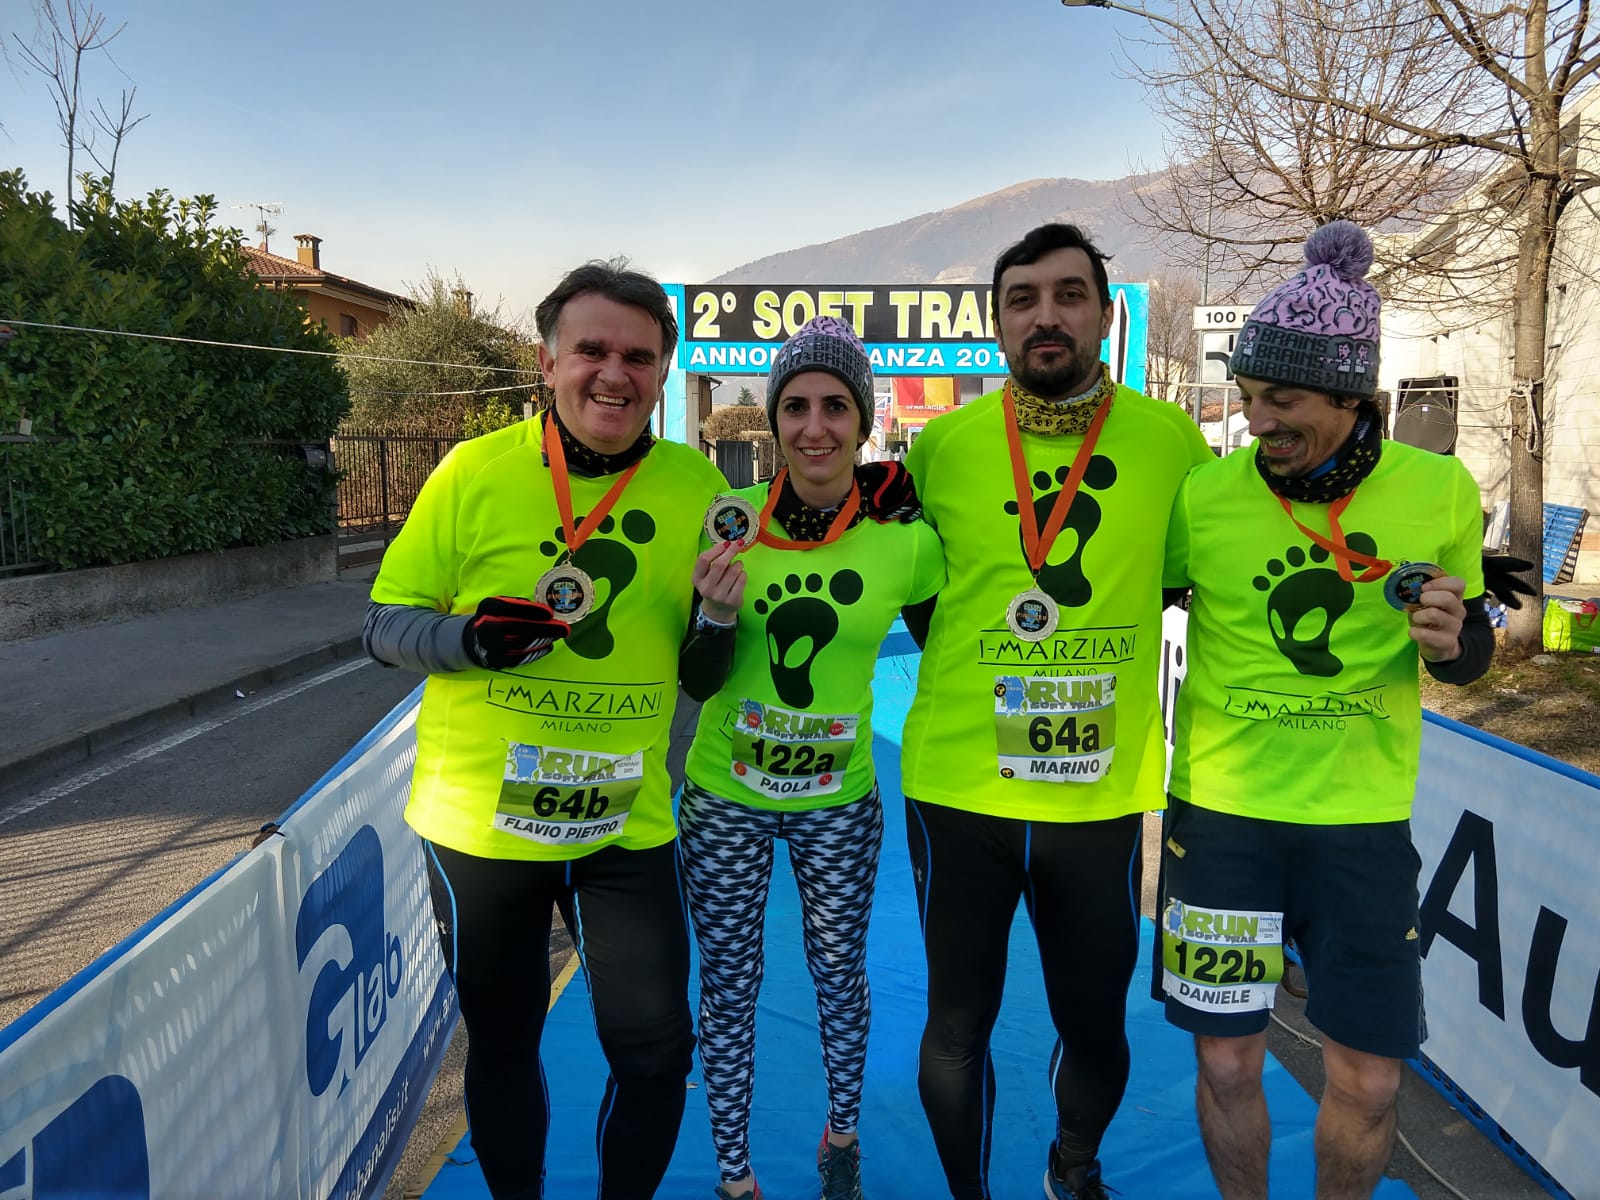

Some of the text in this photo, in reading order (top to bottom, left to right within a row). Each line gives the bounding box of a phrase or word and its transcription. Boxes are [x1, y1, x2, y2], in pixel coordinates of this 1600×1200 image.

[1206, 311, 1236, 323] 100
[1259, 328, 1329, 353] BRAINS
[956, 349, 1006, 367] 201
[1255, 343, 1325, 368] BRAINS
[1251, 359, 1323, 384] BRAINS
[978, 634, 1136, 661] I-MARZIANI
[488, 678, 662, 715] I-MARZIANI
[1027, 679, 1103, 704] RUN
[1030, 700, 1103, 711] SOFT TRAIL
[541, 720, 612, 733] MILANO
[764, 709, 836, 736] RUN
[1028, 716, 1100, 753] 64a
[1278, 718, 1347, 731] MILANO
[541, 751, 616, 777] RUN
[751, 738, 835, 776] 122a
[1030, 759, 1100, 775] MARINO
[760, 777, 812, 793] PAOLA
[533, 786, 609, 820] 64b
[504, 817, 619, 839] FLAVIO PIETRO
[1184, 910, 1259, 937] RUN
[1186, 930, 1258, 943] SOFT TRAIL
[1175, 941, 1266, 984] 122b
[1180, 982, 1251, 1005] DANIELE
